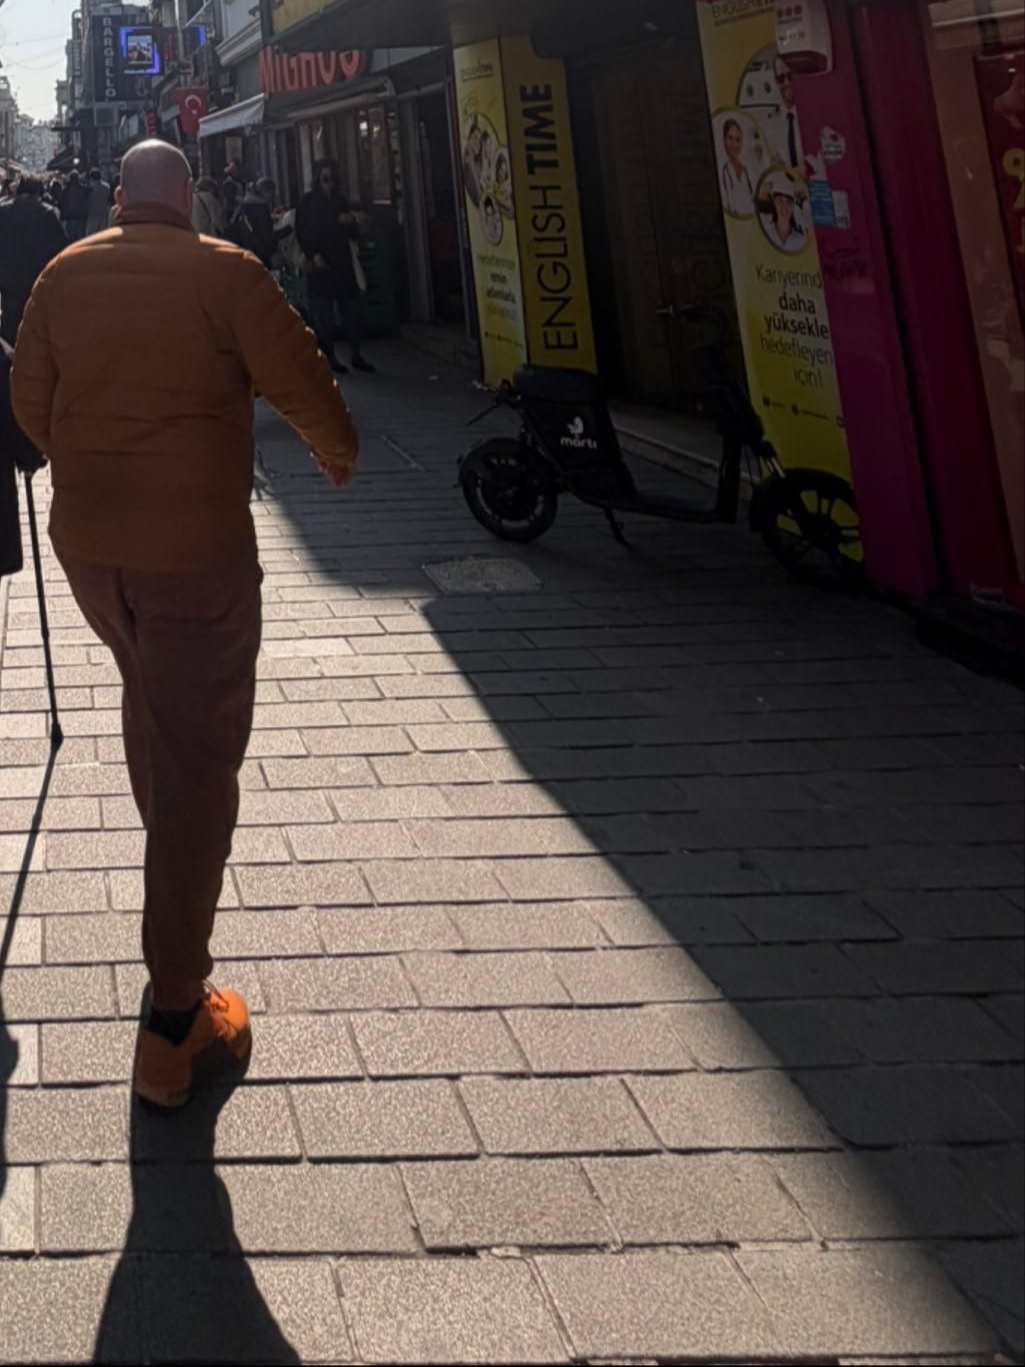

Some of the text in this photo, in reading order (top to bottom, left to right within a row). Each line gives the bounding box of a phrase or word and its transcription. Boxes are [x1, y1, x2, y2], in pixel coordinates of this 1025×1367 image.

[102, 16, 117, 98] BARGELLO
[519, 82, 580, 352] ENGLISH TIME
[778, 290, 817, 315] daha
[760, 332, 834, 367] hedefleyen
